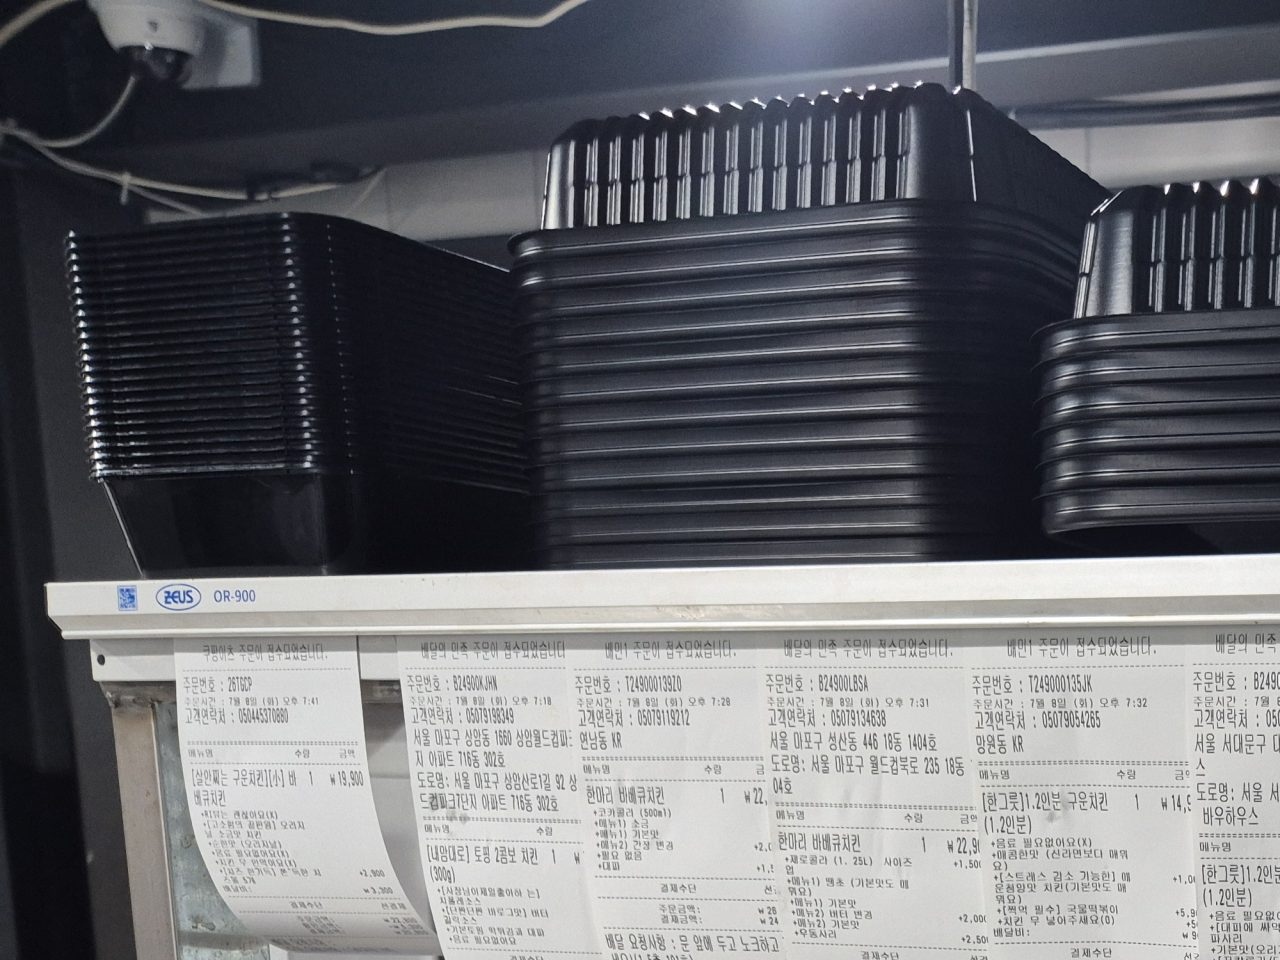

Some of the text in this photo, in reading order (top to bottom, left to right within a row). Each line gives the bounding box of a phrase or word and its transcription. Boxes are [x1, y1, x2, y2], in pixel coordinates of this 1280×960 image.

[214, 590, 256, 603] OR-900
[1215, 632, 1248, 655] 배달의
[1255, 632, 1276, 654] 민족
[766, 675, 804, 694] 주문번호
[972, 676, 1012, 696] 주문번호
[1193, 672, 1236, 693] 주문번호
[586, 786, 613, 805] 한마리
[495, 847, 516, 864] 2콤보
[521, 848, 538, 864] 치킨
[430, 865, 455, 883] (300g)
